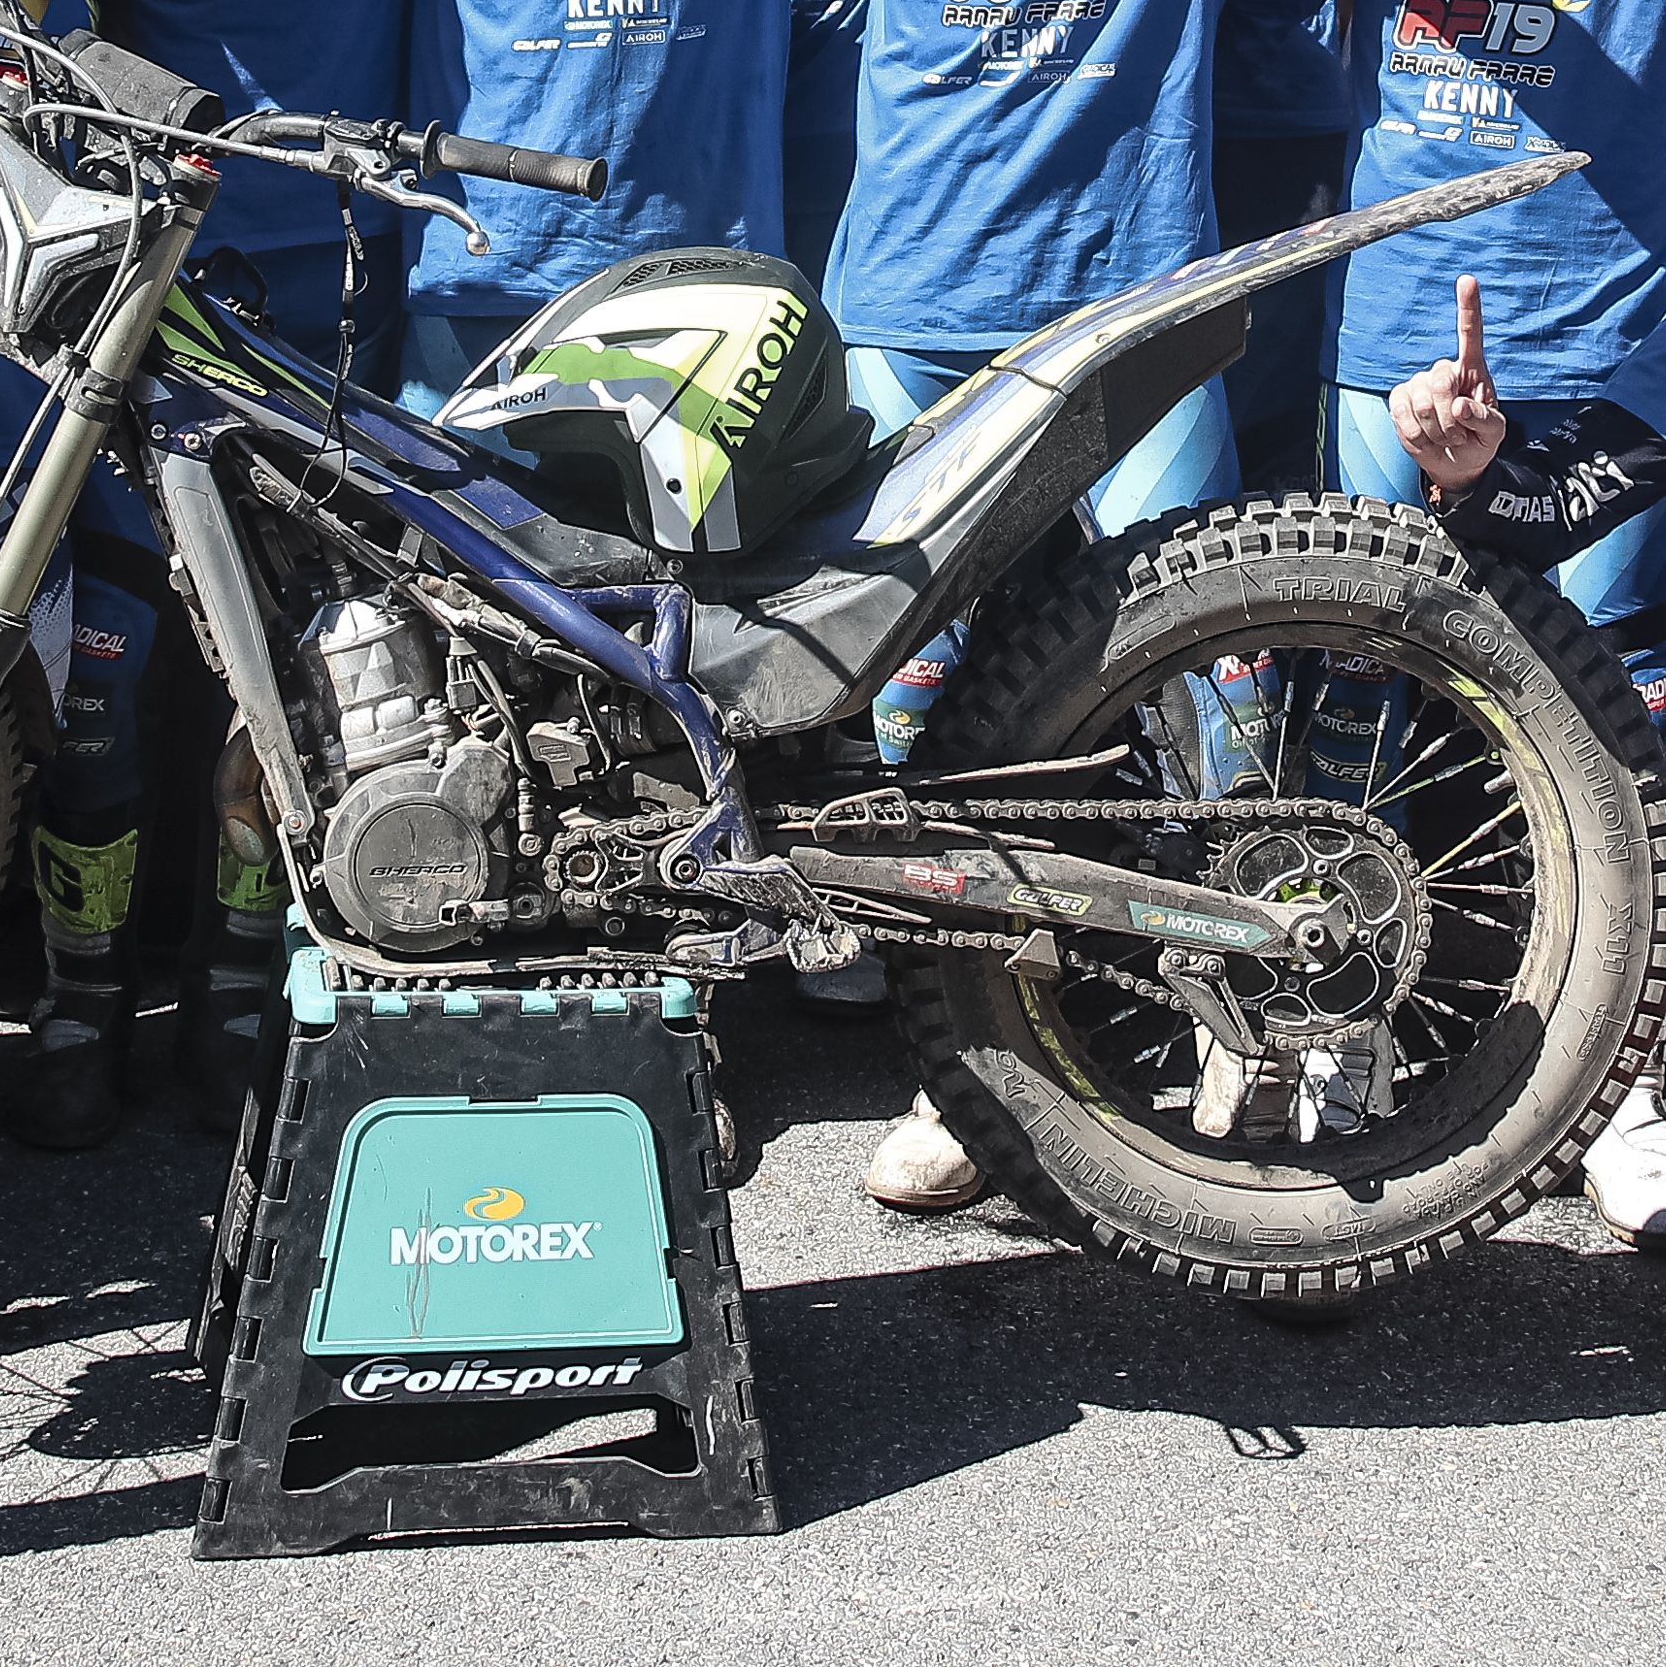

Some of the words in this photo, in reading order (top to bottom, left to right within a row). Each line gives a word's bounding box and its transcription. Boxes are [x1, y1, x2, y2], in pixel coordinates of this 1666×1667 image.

[981, 26, 1074, 57] KENNY
[1424, 80, 1518, 117] KENNY
[171, 353, 268, 397] SHERCO
[710, 292, 809, 448] AIROH
[490, 387, 546, 409] AIROH
[1273, 575, 1407, 614] TRIAL
[64, 695, 105, 711] OREX
[1166, 912, 1249, 944] MOTOREX
[1040, 1122, 1237, 1244] MICHELIN
[389, 1222, 595, 1266] MOTOREX
[351, 1356, 644, 1400] Polisport
